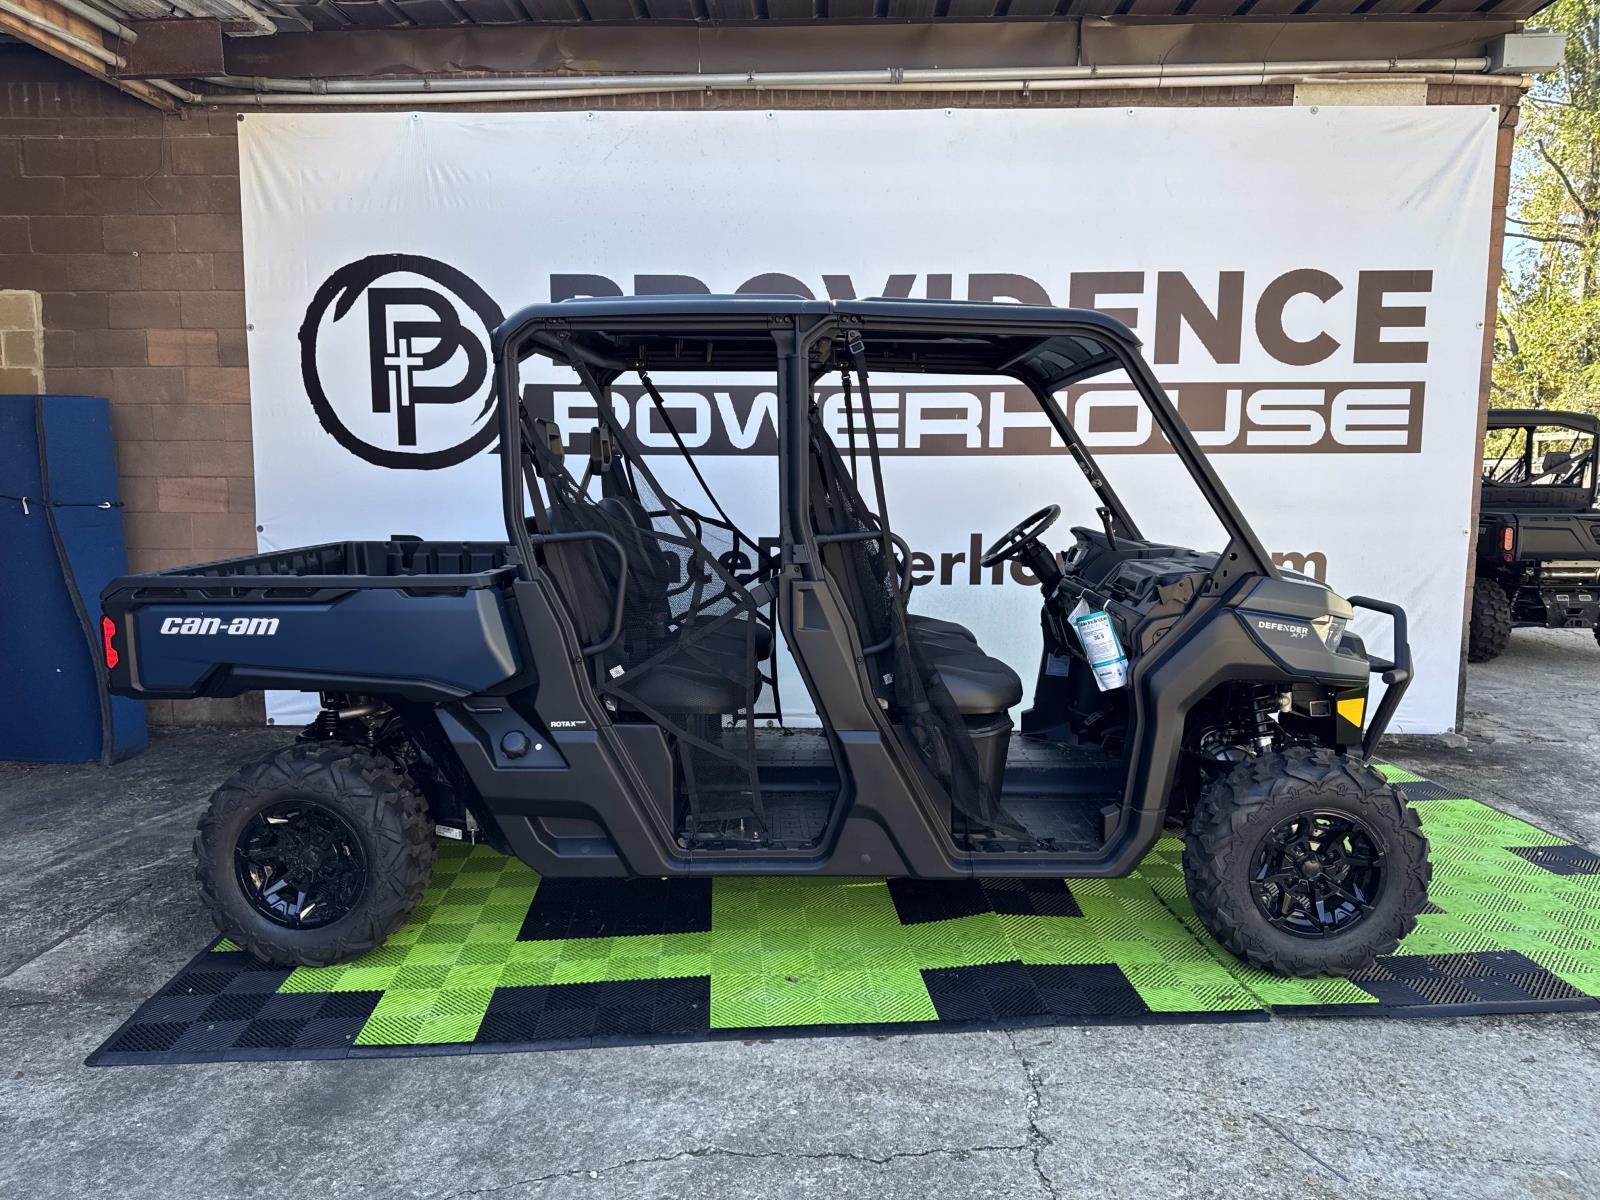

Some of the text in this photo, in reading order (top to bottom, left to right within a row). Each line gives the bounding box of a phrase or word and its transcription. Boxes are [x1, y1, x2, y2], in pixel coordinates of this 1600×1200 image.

[160, 617, 280, 635] can-am
[1258, 621, 1309, 634] DEFENDER
[550, 720, 576, 728] ROTAX
